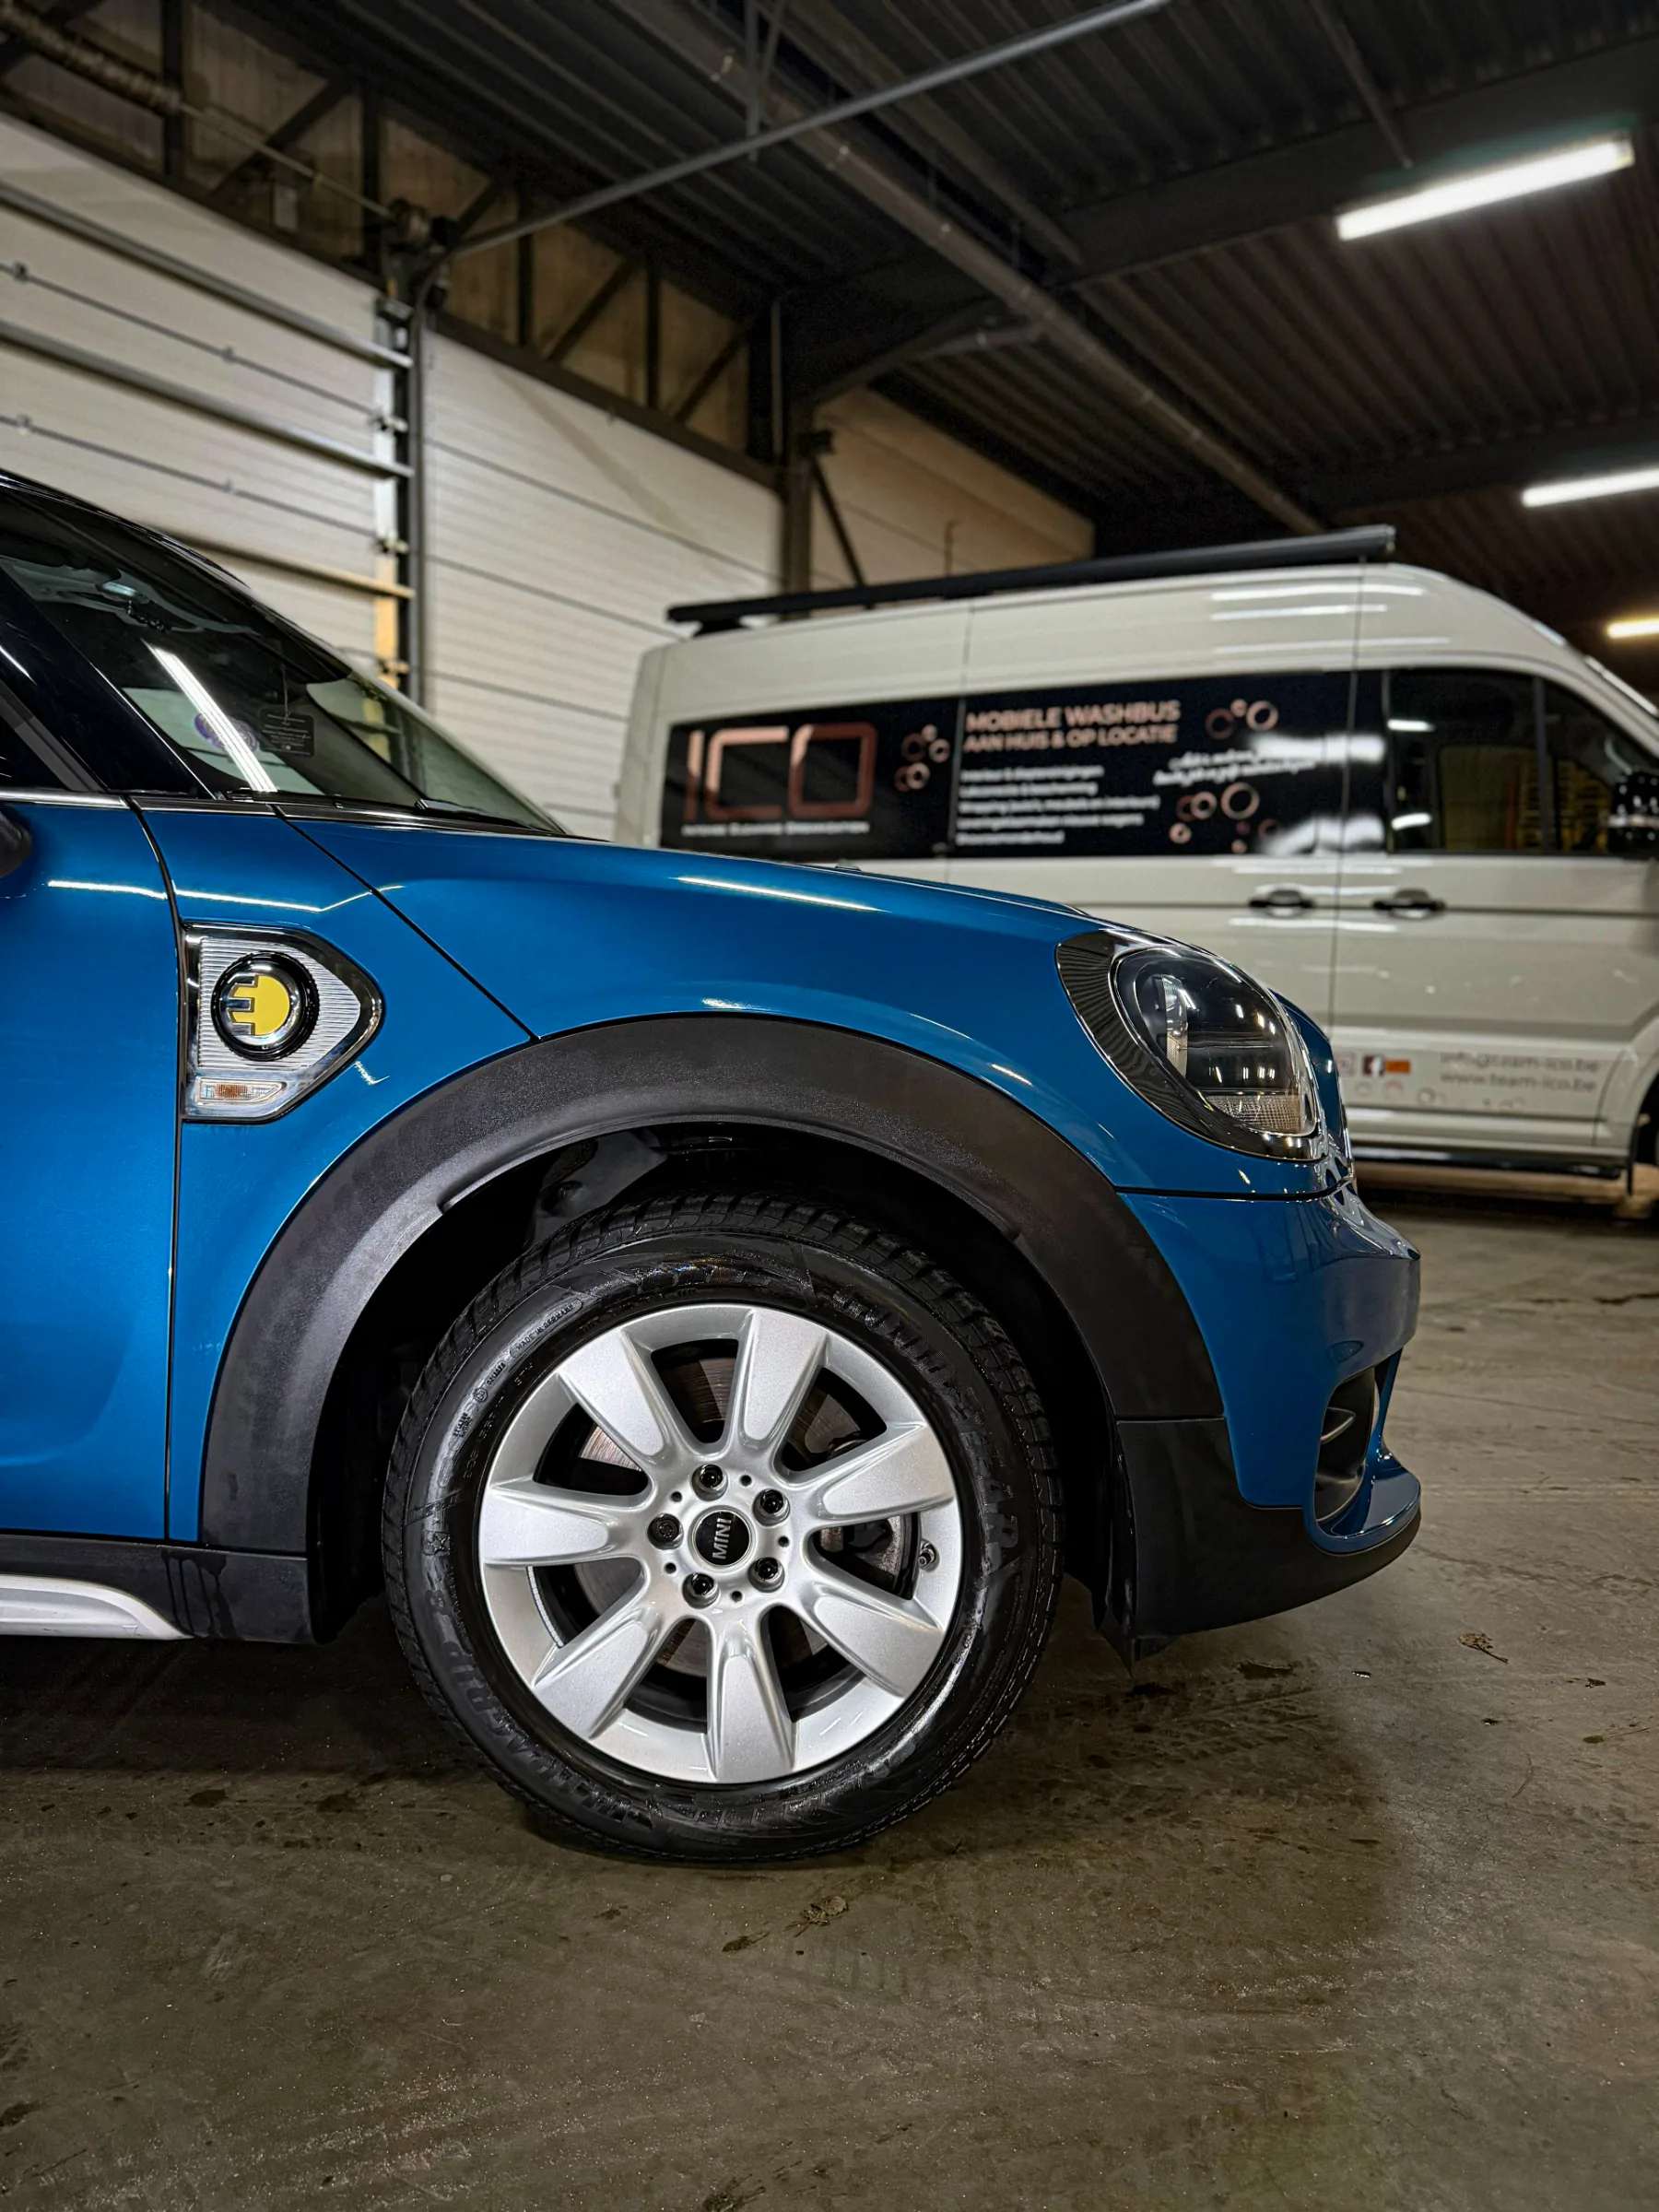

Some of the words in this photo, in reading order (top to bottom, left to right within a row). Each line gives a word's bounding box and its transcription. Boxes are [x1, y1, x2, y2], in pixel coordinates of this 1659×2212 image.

[966, 707, 1062, 732] MOBIELE
[1064, 700, 1181, 727] WASHBUS
[963, 734, 1004, 753] AAN
[1005, 730, 1049, 750] HUIS
[1065, 727, 1097, 748] OP
[1097, 724, 1178, 747] LOCATIE
[712, 1517, 733, 1560] MINI
